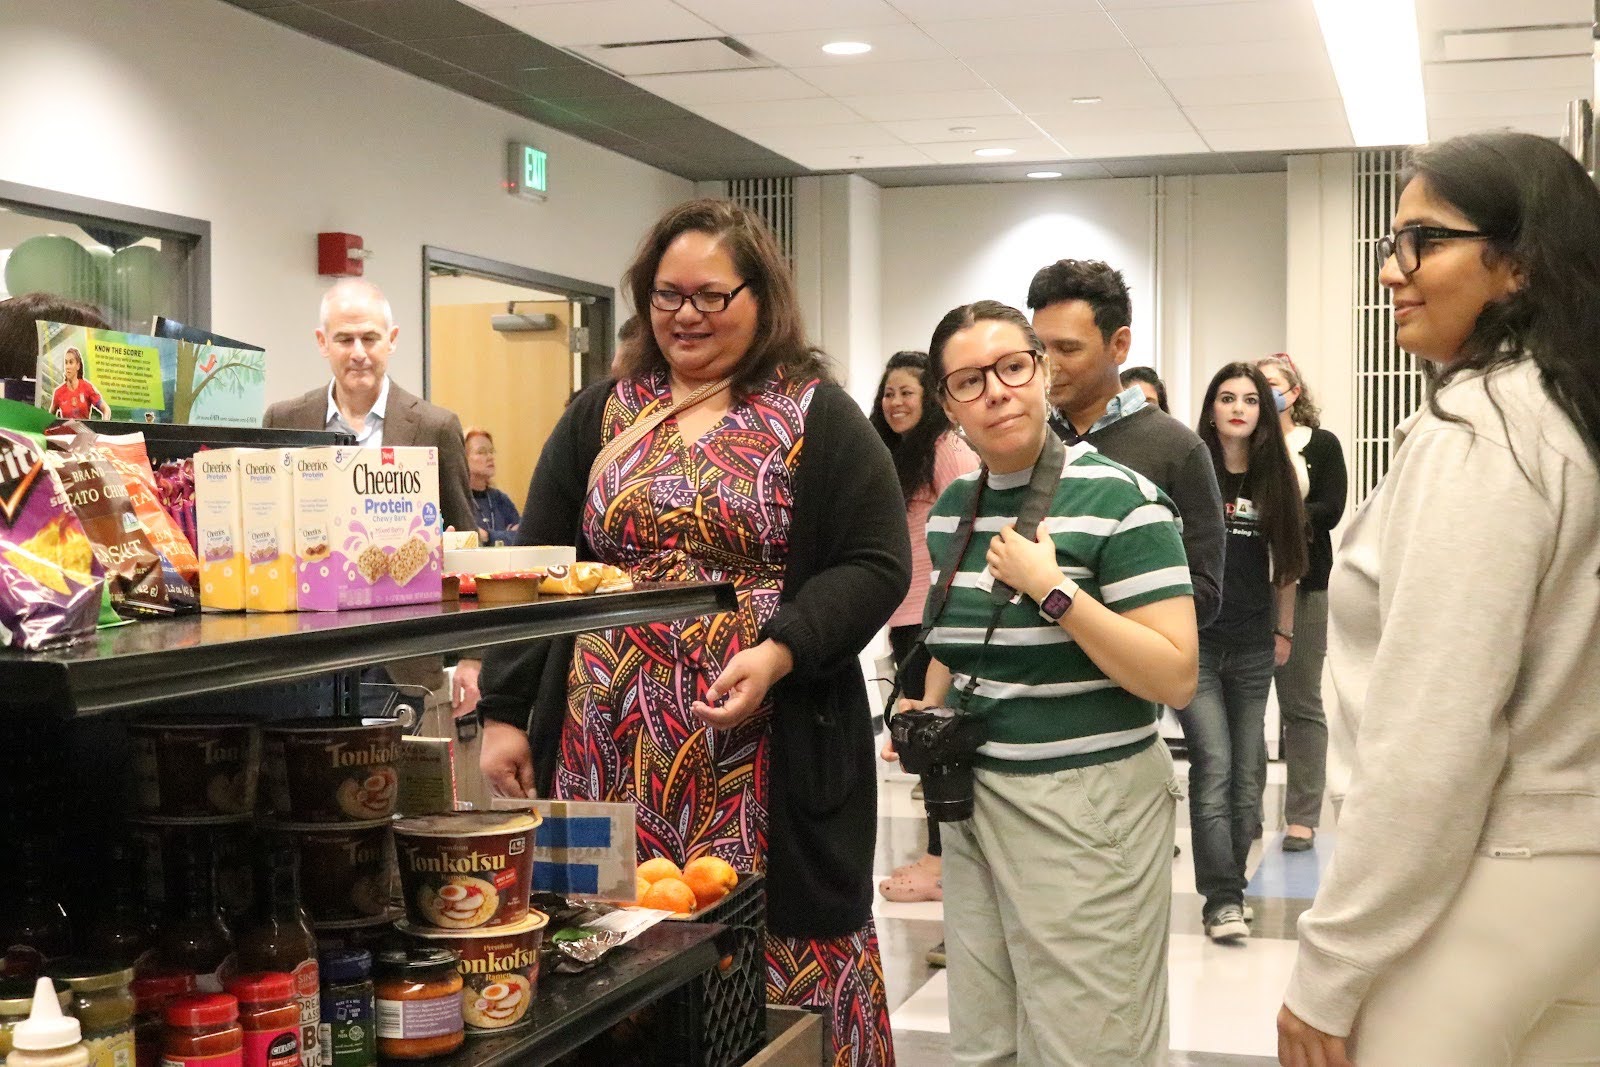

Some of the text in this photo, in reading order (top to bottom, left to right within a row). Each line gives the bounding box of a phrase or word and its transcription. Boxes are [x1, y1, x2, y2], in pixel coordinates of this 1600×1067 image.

[526, 148, 546, 191] EXIT
[94, 344, 144, 358] KNOW THE SCORE!
[428, 449, 434, 460] 5
[202, 461, 232, 473] Cheerios
[245, 463, 276, 475] Cheerios
[297, 459, 328, 472] Cheerios
[71, 467, 106, 483] BRAND
[353, 462, 421, 495] Cheerios
[364, 497, 413, 514] Protein
[1232, 528, 1252, 537] Being
[404, 847, 506, 873] Tonkotsu
[456, 947, 537, 975] onkotsu
